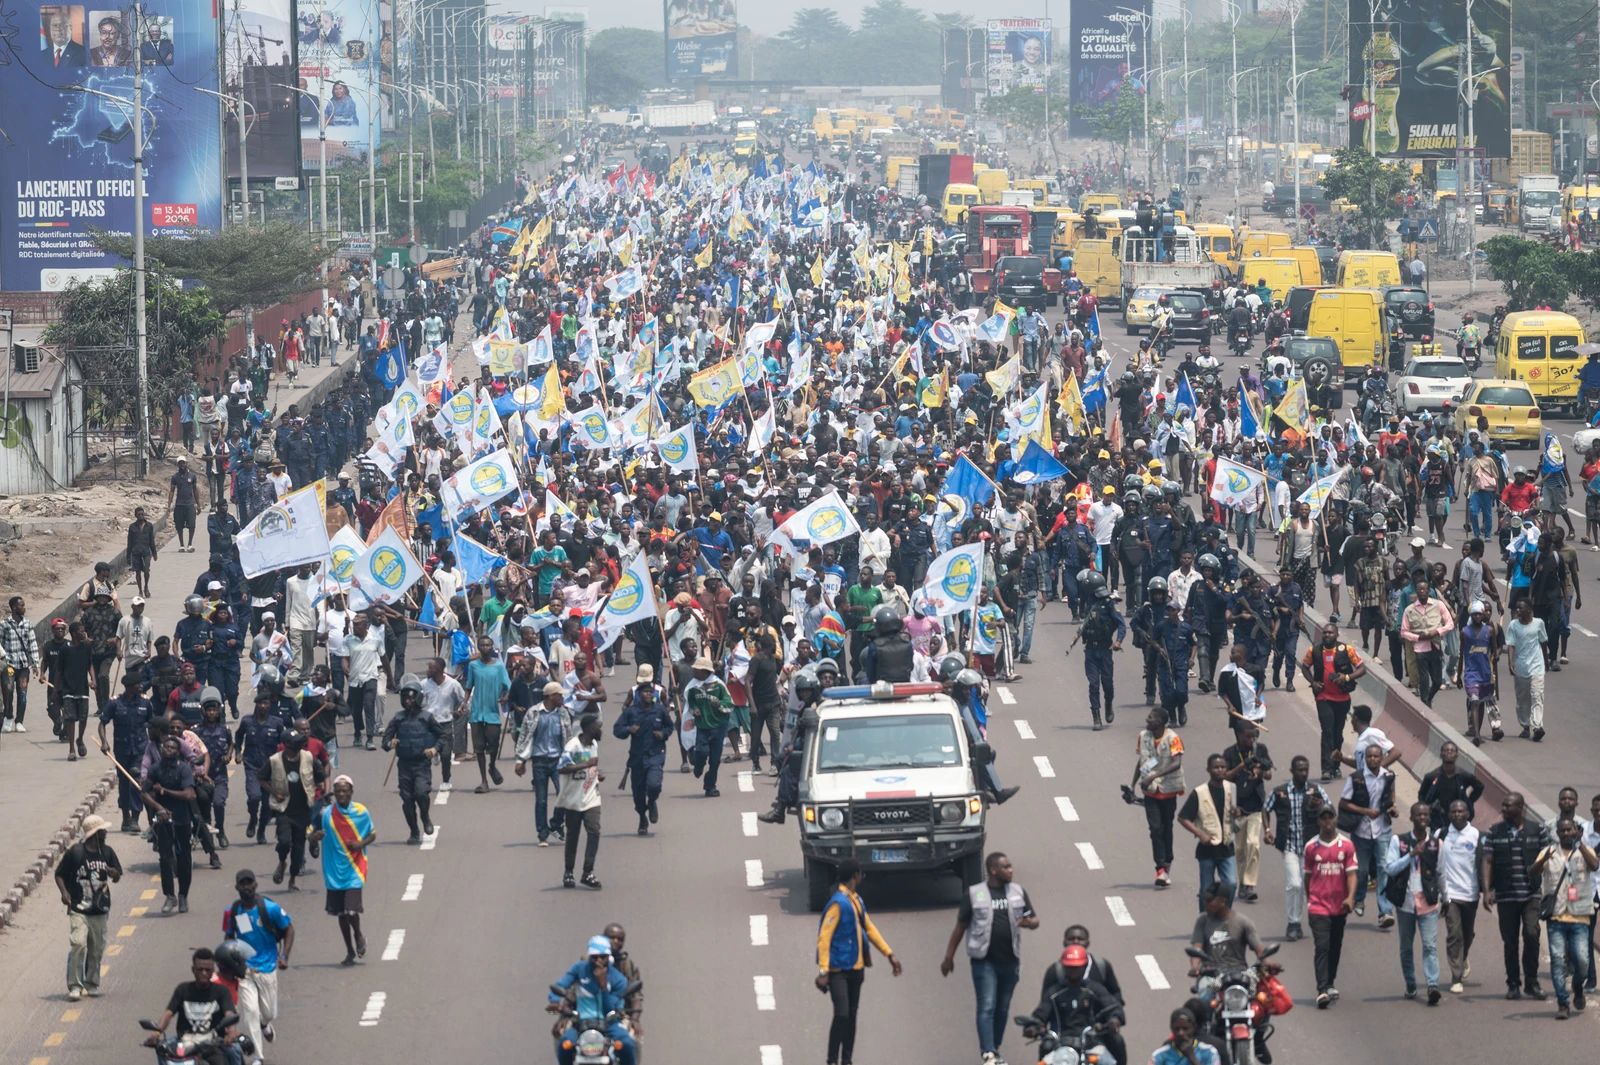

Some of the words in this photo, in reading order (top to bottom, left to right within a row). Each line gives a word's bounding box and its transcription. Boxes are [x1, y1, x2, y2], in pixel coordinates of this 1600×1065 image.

[1081, 33, 1127, 43] OPTIMISÉ
[1081, 44, 1093, 52] LA
[1409, 124, 1438, 138] SUKA
[1441, 123, 1457, 137] NA
[17, 180, 92, 198] LANCEMENT
[97, 179, 149, 198] OFFICIL
[18, 200, 35, 218] DU
[38, 200, 105, 218] RDC-PASS
[164, 206, 173, 214] 13
[175, 206, 195, 215] Juin
[18, 231, 37, 239] Notre
[37, 230, 72, 239] identifiant
[18, 241, 40, 249] Fiable,
[40, 240, 69, 249] Sécurisé
[18, 251, 33, 259] RDC
[34, 251, 70, 259] totalement
[71, 250, 105, 260] digitalisée
[1553, 364, 1575, 379] 307
[1428, 475, 1441, 485] 23
[874, 811, 910, 819] TOYOTA
